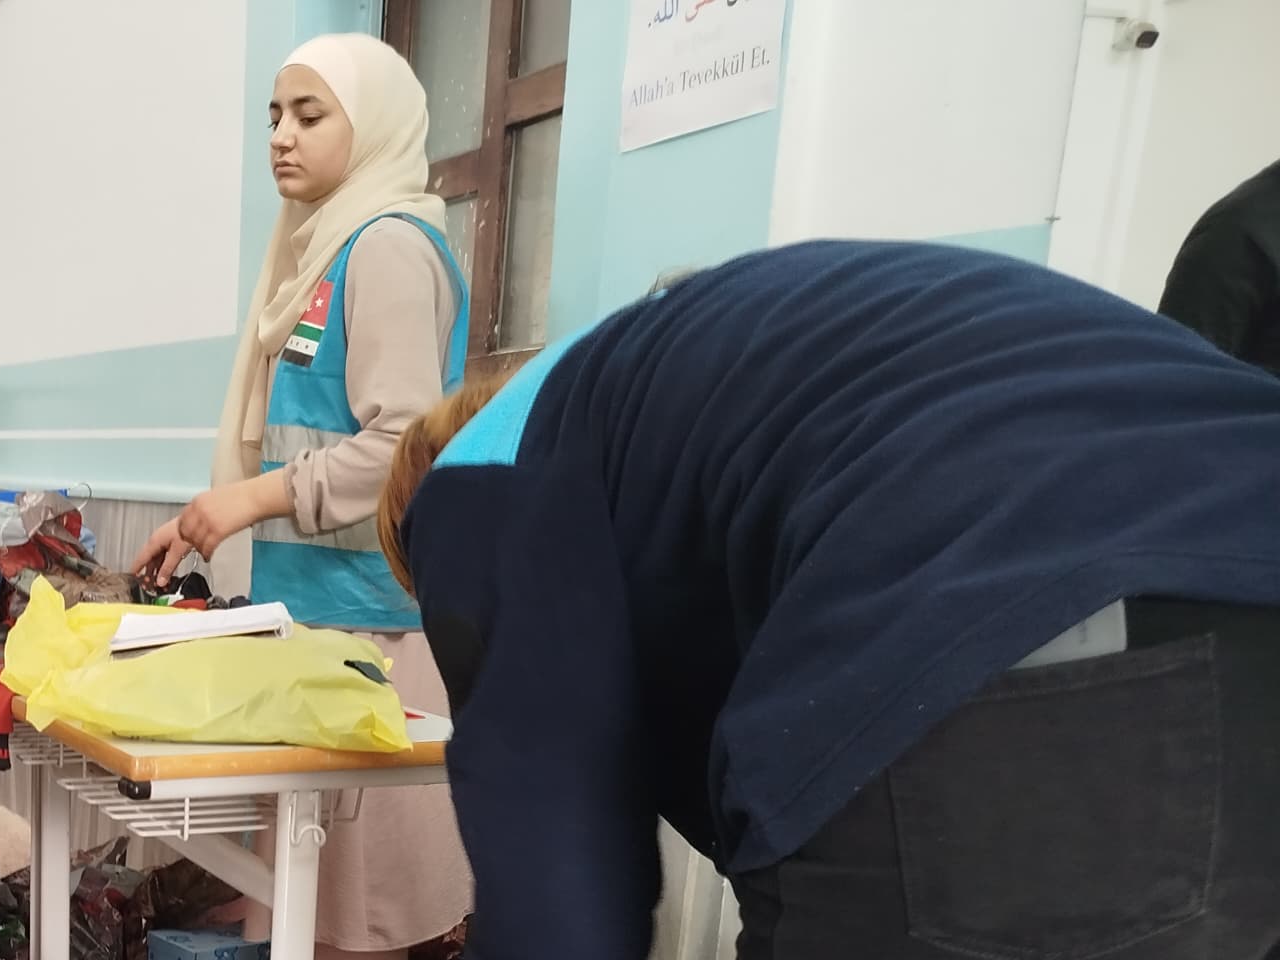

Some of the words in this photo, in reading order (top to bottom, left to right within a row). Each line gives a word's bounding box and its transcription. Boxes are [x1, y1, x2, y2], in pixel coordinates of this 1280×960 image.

[630, 76, 674, 108] Allah'a
[680, 50, 745, 92] Tevekkül
[751, 46, 770, 69] Et.
